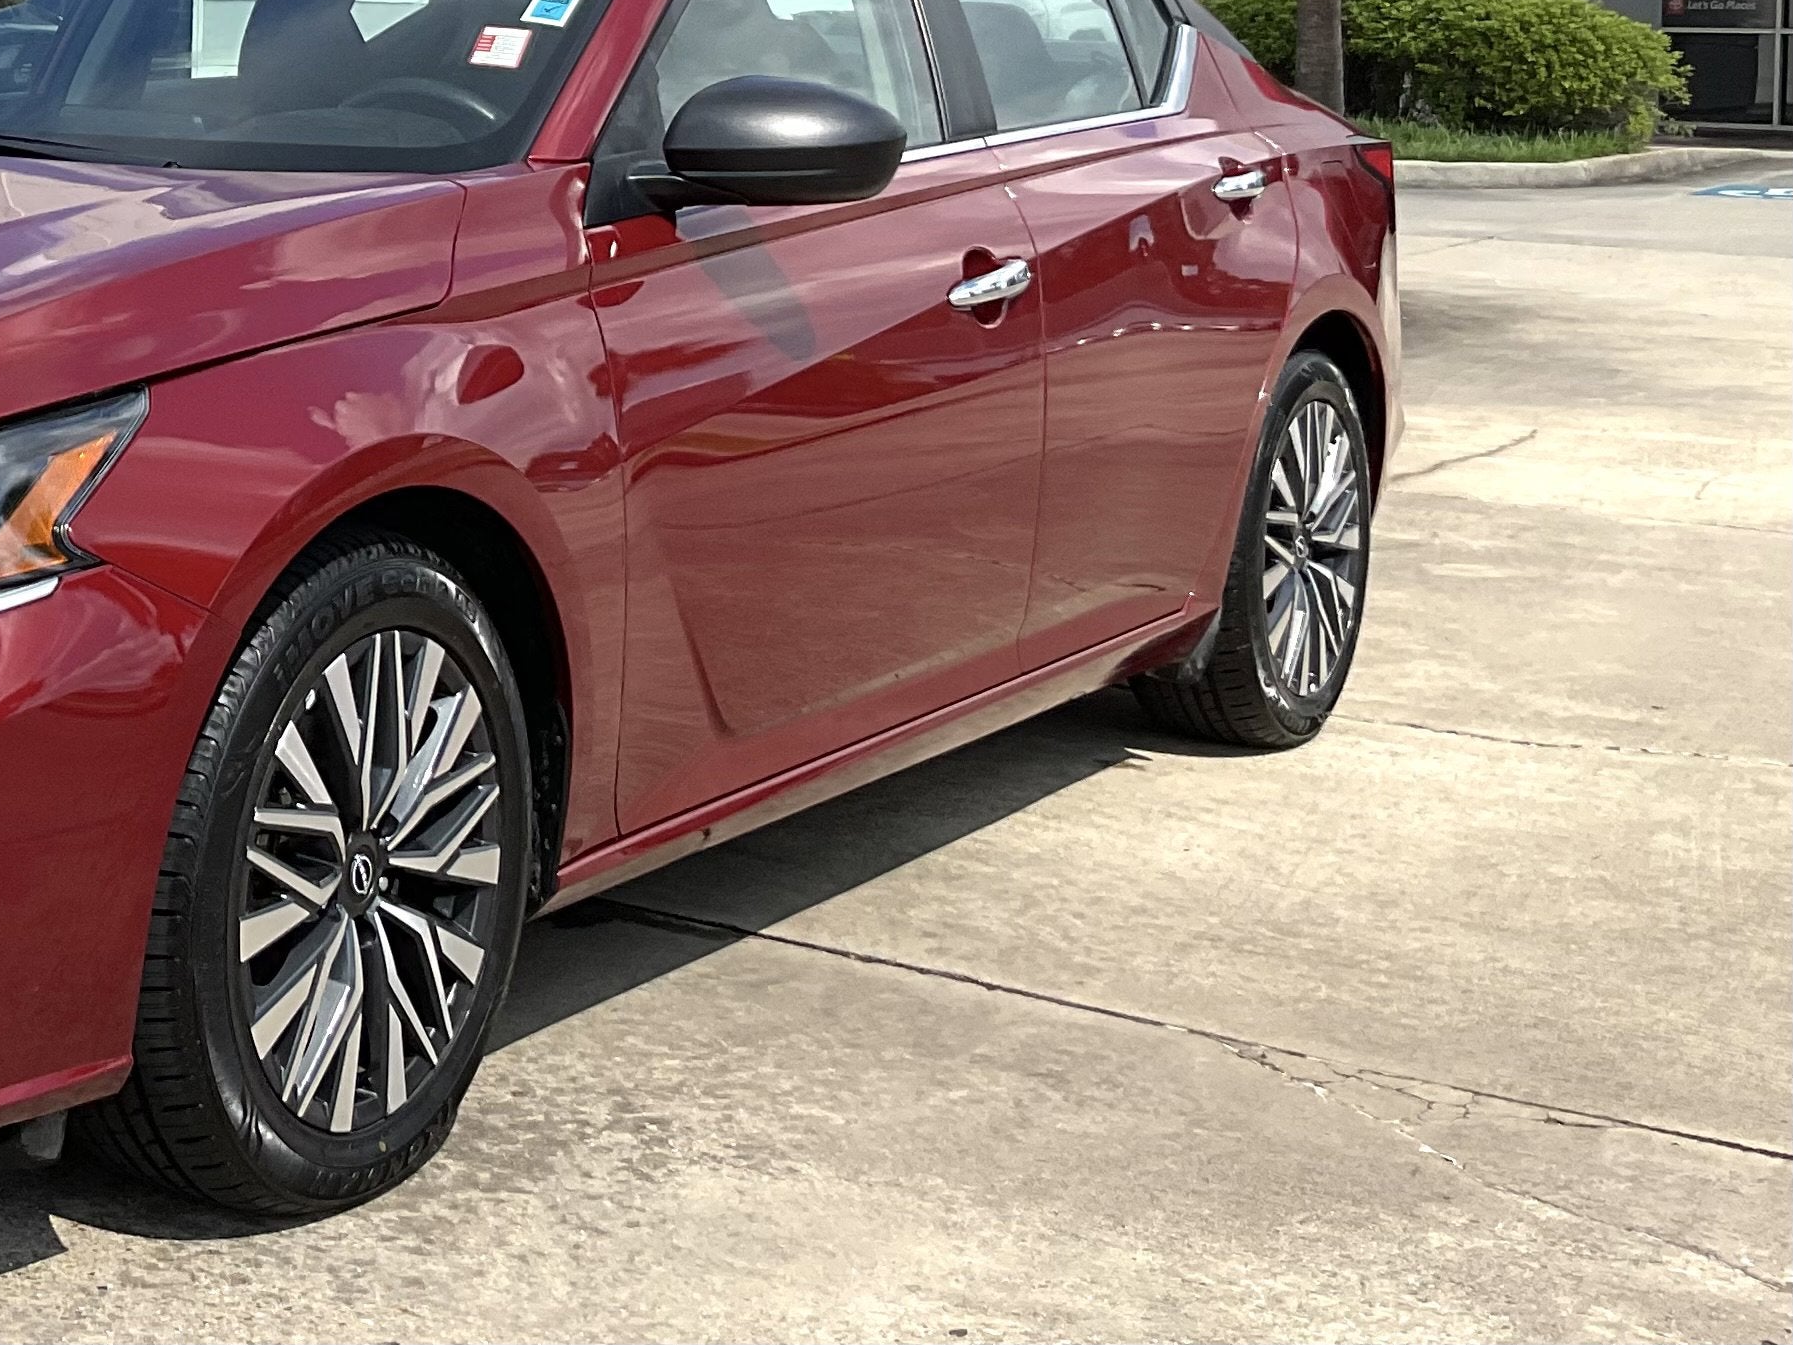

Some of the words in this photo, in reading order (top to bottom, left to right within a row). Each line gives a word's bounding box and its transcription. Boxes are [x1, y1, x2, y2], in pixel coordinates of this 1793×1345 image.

[1687, 0, 1708, 10] Let's
[1710, 0, 1725, 10] Go
[1726, 0, 1757, 10] Places
